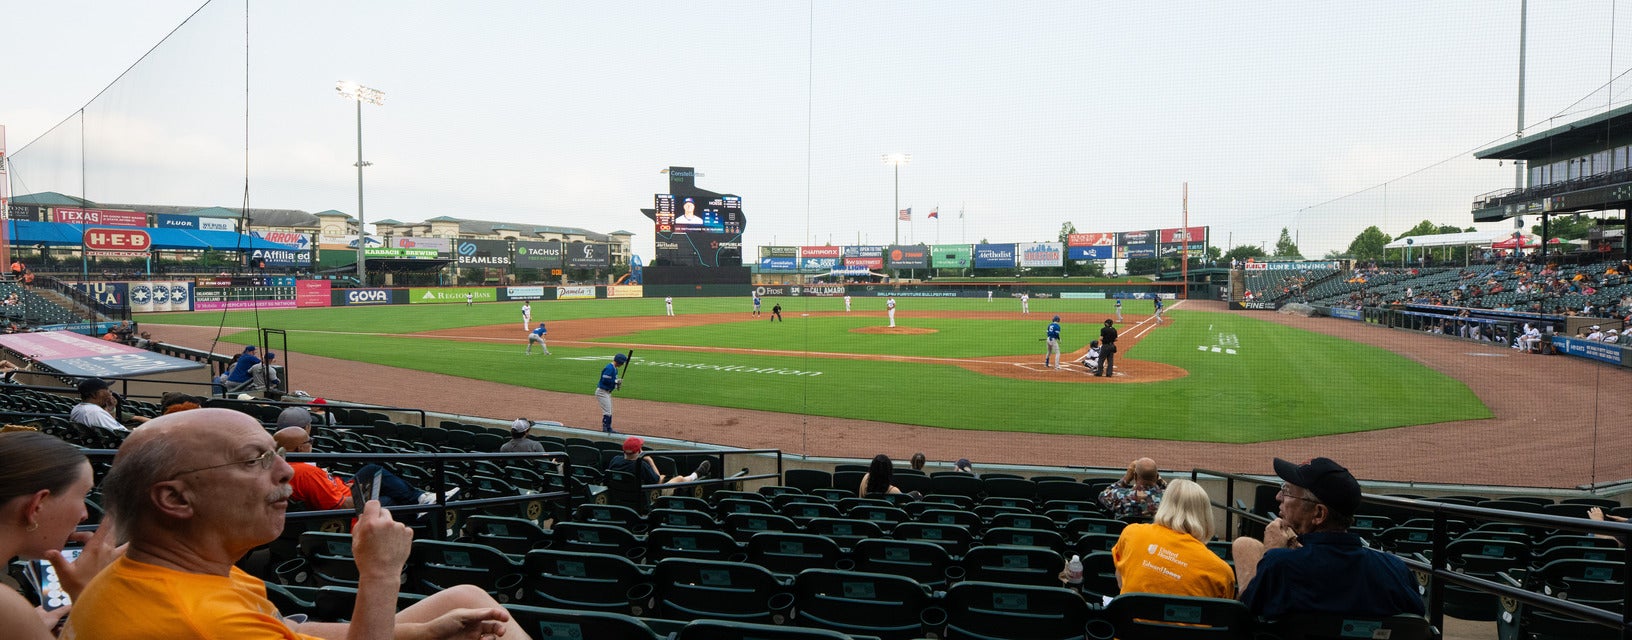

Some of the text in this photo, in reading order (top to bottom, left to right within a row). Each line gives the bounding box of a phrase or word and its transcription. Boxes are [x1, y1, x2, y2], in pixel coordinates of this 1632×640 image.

[60, 211, 98, 222] TEXAS
[264, 232, 301, 242] ARROW
[349, 290, 387, 302] GOYA
[1159, 547, 1179, 558] United
[1158, 551, 1188, 567] Healthcare
[1142, 560, 1182, 580] Edward Jones
